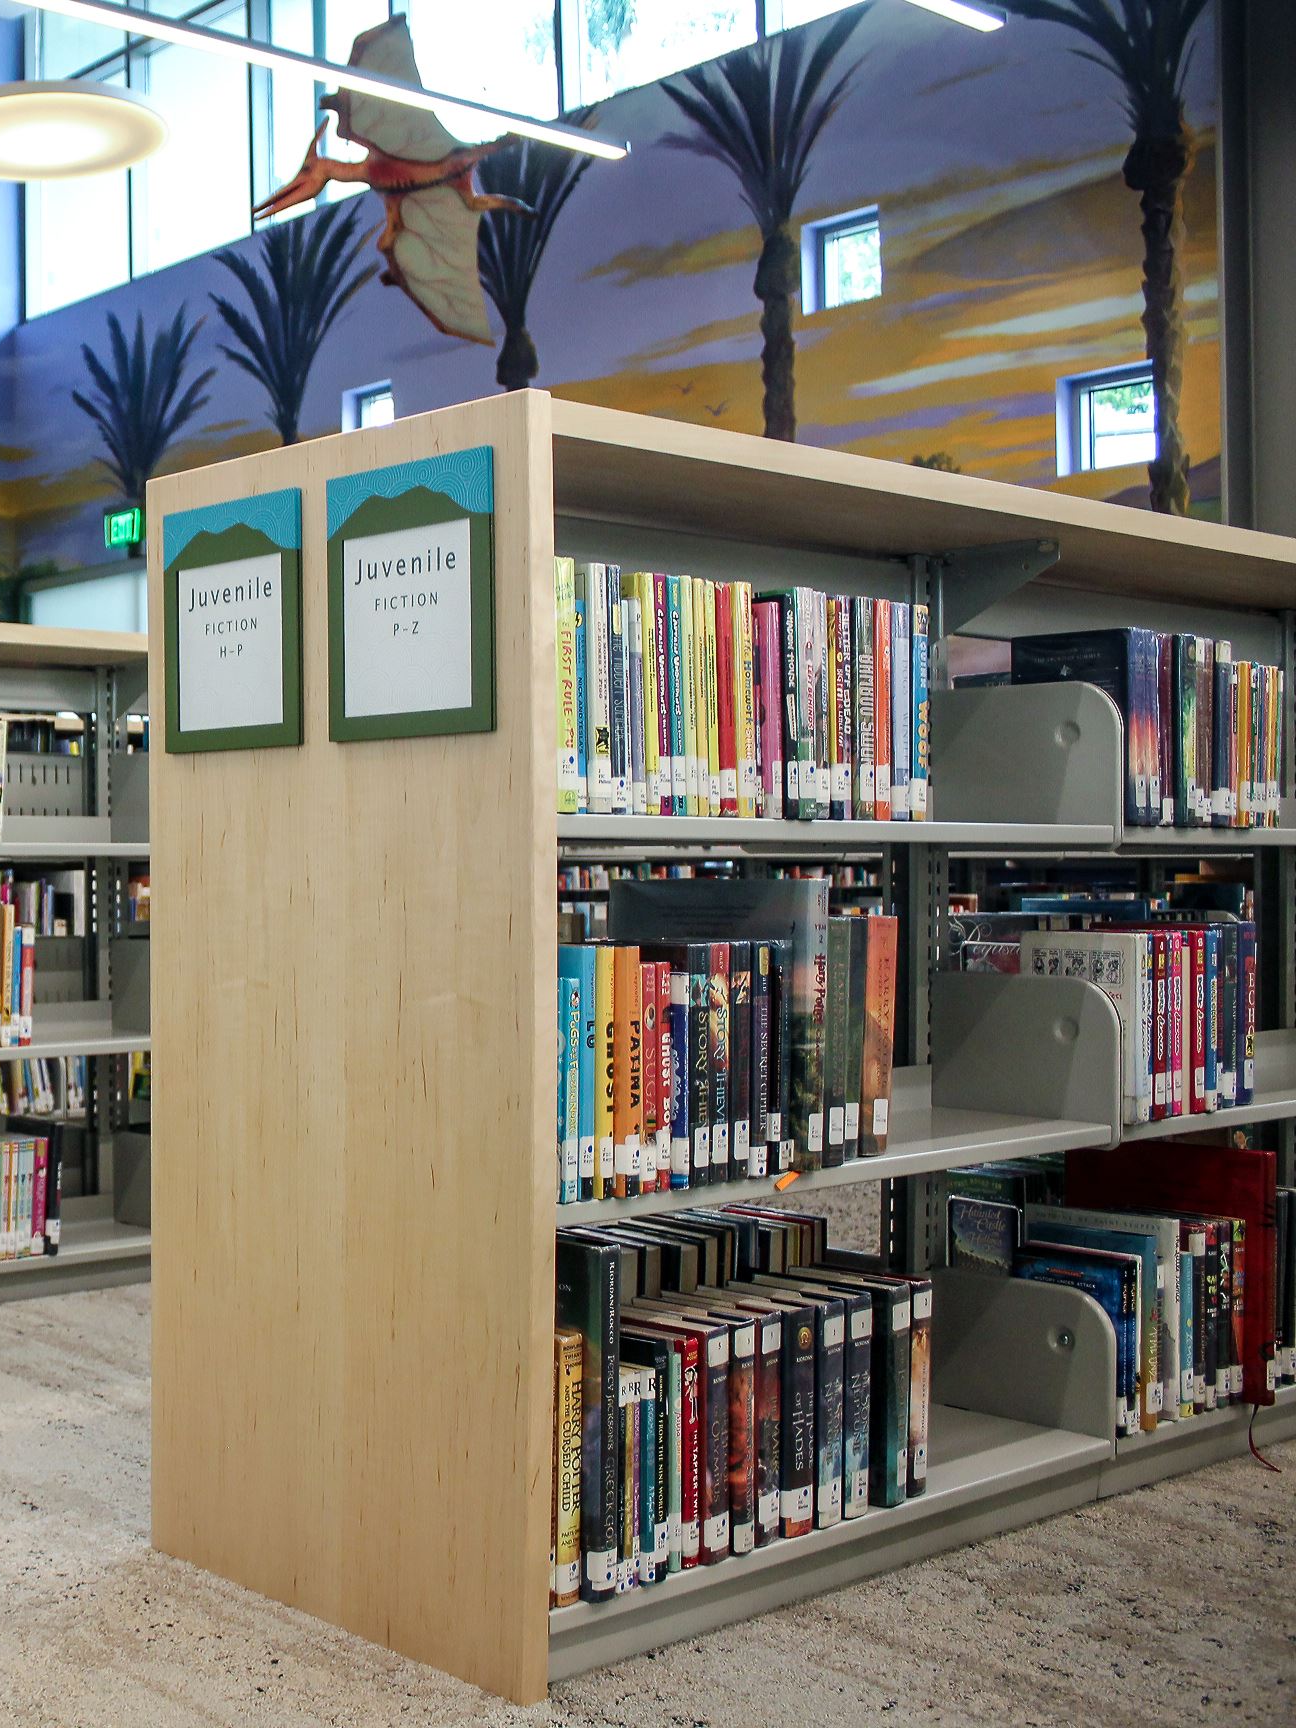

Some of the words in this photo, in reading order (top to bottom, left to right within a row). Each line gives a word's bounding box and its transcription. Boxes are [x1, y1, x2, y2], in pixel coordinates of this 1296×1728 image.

[355, 547, 457, 586] Juvenile
[189, 576, 273, 613] Juvenile
[374, 591, 439, 612] FICTION
[204, 617, 258, 637] FICTION
[656, 608, 665, 655] CAPTAIN
[672, 610, 680, 655] CAPTAIN
[785, 609, 795, 650] SHADOW
[841, 612, 851, 661] BETTER
[560, 630, 572, 675] FIRST
[786, 651, 796, 688] HOUSE
[561, 679, 573, 716] RULE
[743, 660, 753, 726] Homework
[843, 663, 852, 689] OFF
[807, 687, 815, 730] BEHINDS
[916, 700, 930, 769] WOOF
[812, 953, 827, 987] Harry
[760, 1006, 768, 1029] THE
[812, 988, 827, 1025] Potter
[694, 1011, 710, 1074] STORY
[713, 1007, 728, 1063] STORY
[759, 1032, 768, 1080] SECRET
[661, 1032, 671, 1087] GHOST
[644, 1047, 656, 1117] SUGA
[715, 1067, 727, 1125] THIEVE
[608, 1261, 616, 1345] RIORDAN/ROCCO
[1077, 1281, 1096, 1289] ATTACK
[606, 1354, 616, 1391] PERCY
[621, 1386, 626, 1396] R
[628, 1382, 634, 1391] R
[634, 1382, 641, 1396] R
[648, 1378, 656, 1392] R
[571, 1380, 582, 1436] HARRY
[795, 1392, 802, 1408] OF
[562, 1420, 572, 1469] CURSED
[711, 1420, 722, 1503] OLYMPUS
[792, 1410, 805, 1471] HADES
[570, 1445, 582, 1517] POTTER
[604, 1456, 616, 1514] GREEK
[691, 1445, 699, 1490] TAPPER
[562, 1471, 572, 1512] CHILD
[604, 1514, 616, 1550] GOD
